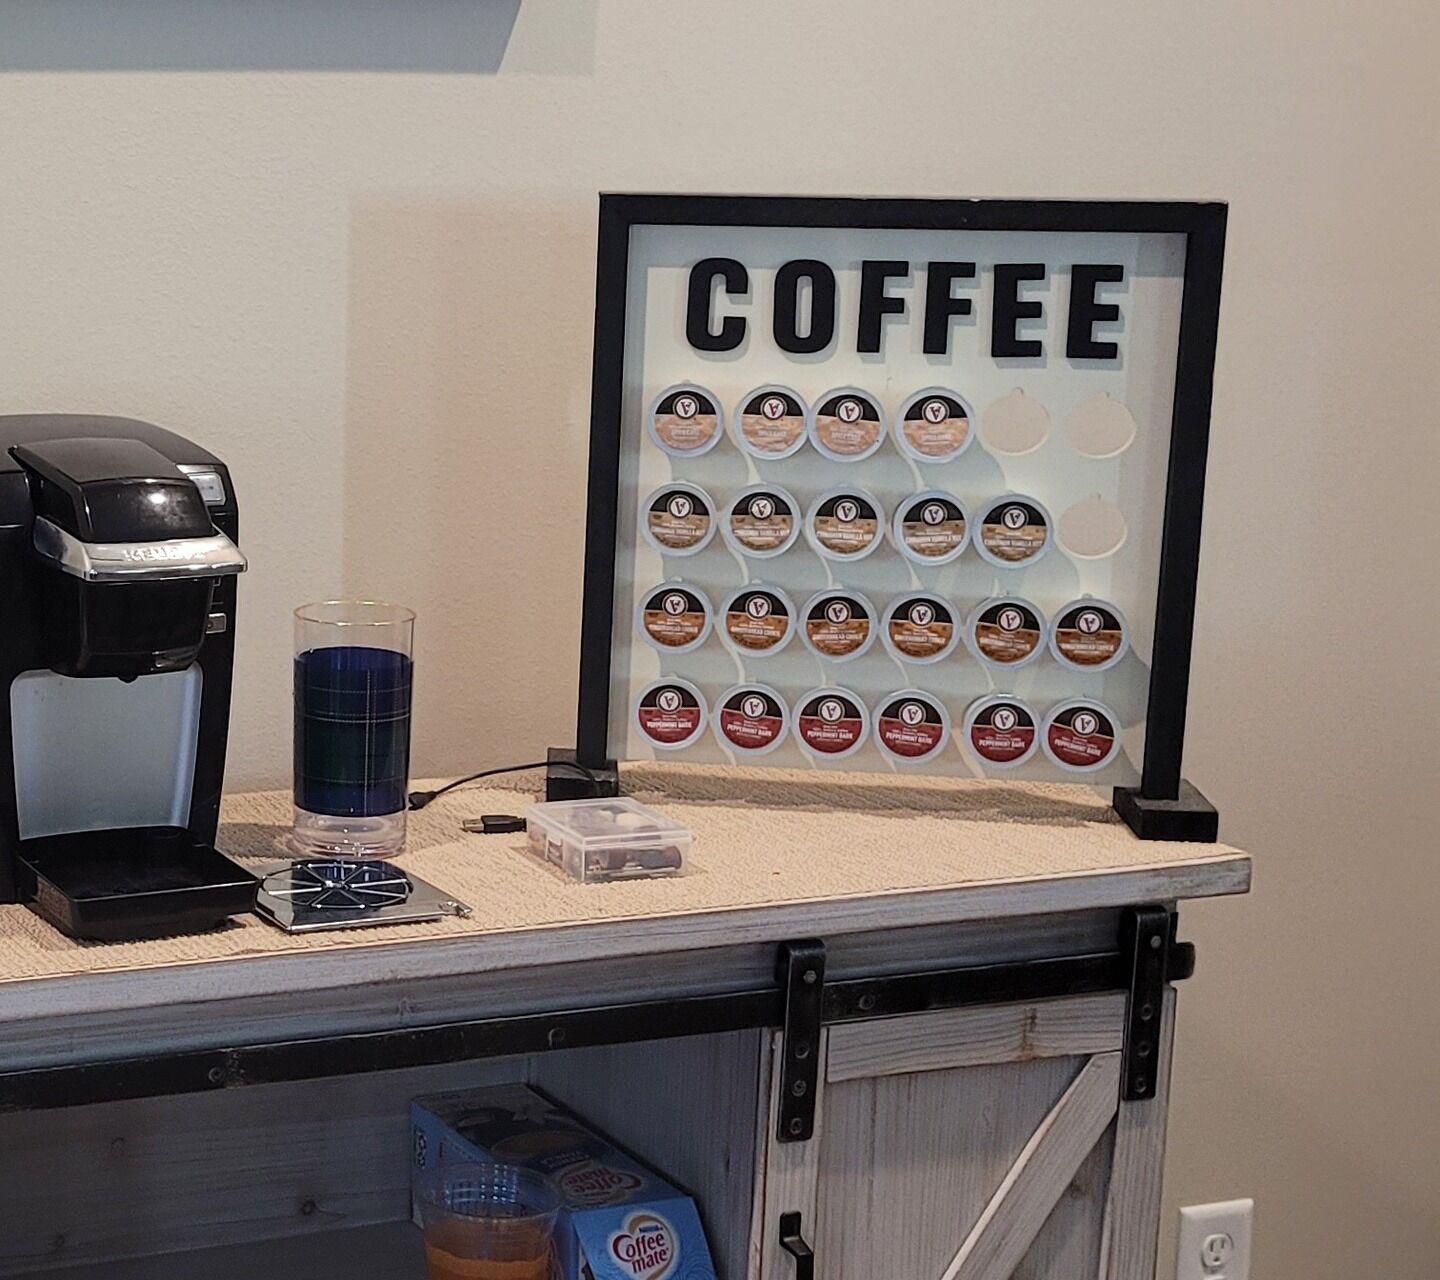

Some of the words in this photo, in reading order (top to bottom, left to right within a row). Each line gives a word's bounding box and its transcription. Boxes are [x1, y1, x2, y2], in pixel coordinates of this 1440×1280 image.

[685, 257, 1125, 359] COFFEE
[613, 1233, 665, 1262] Coffee
[632, 1248, 667, 1274] mate
